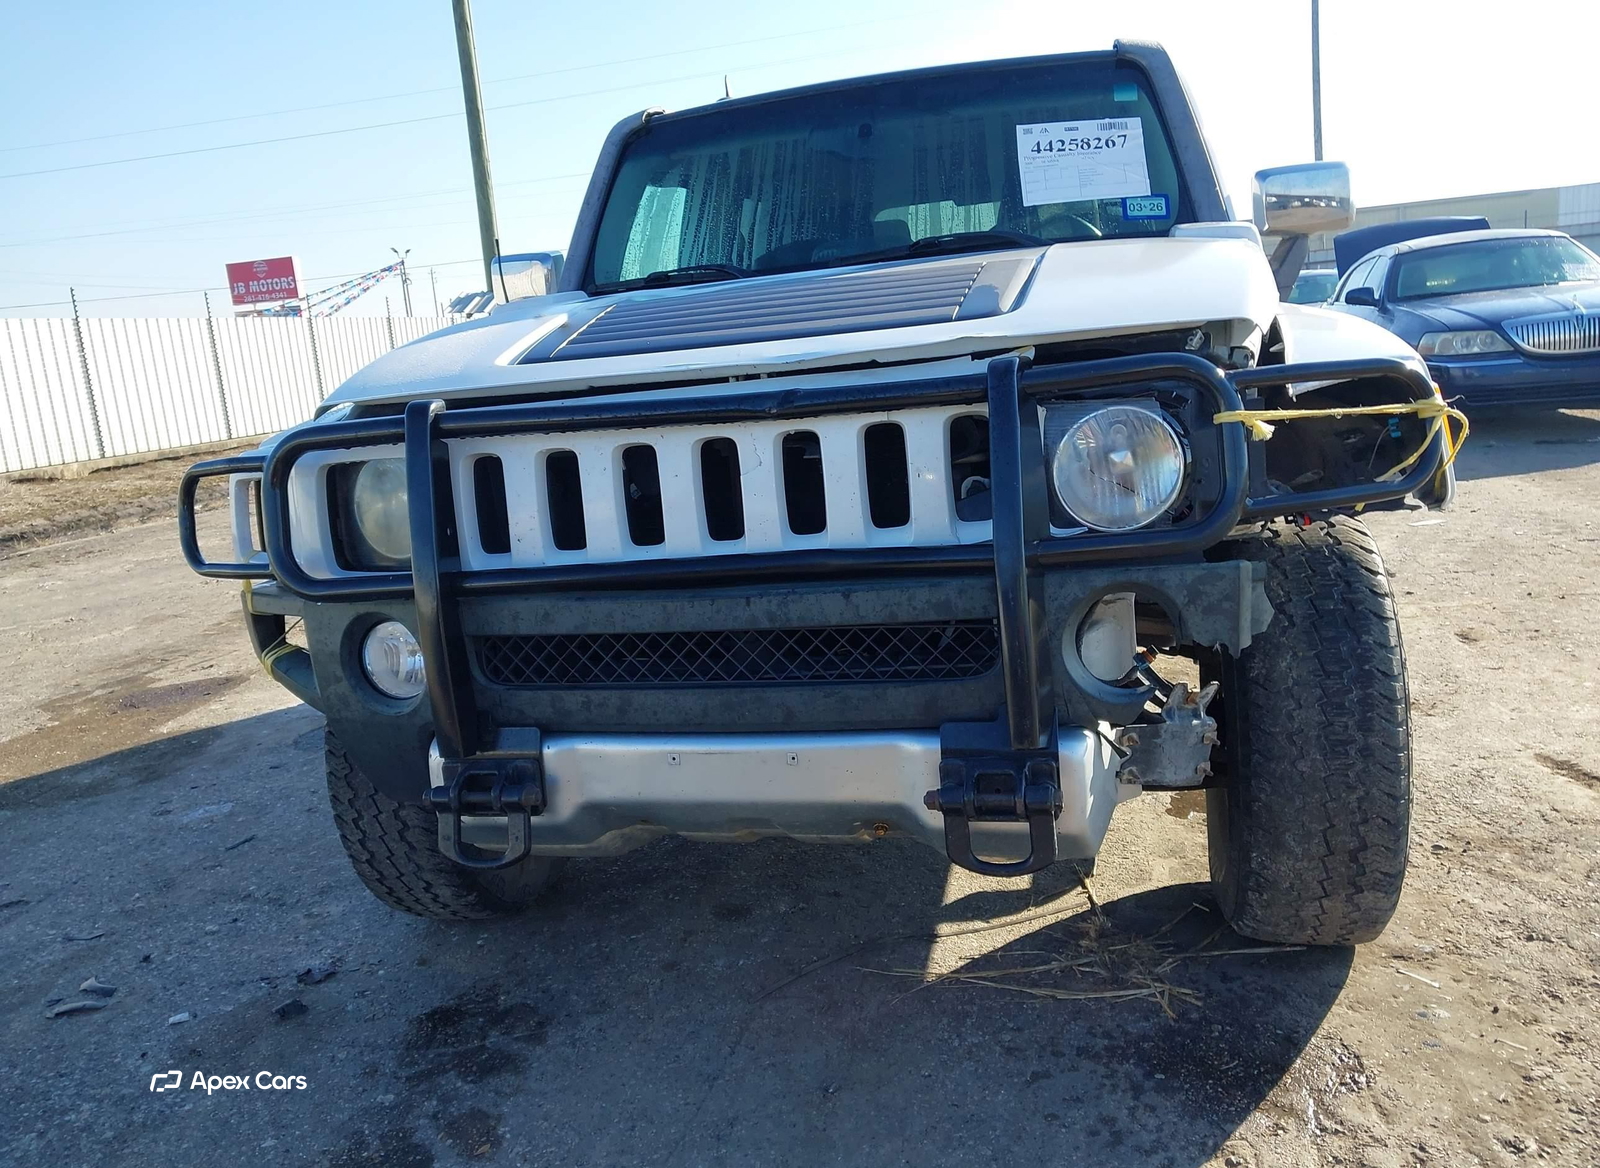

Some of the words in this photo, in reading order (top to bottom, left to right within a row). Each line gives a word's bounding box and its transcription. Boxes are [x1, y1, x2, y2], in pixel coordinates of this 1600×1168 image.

[1031, 134, 1127, 154] 44258267
[1128, 202, 1143, 212] 03
[1149, 201, 1164, 212] 26
[233, 282, 246, 295] JB
[249, 276, 295, 292] MOTORS
